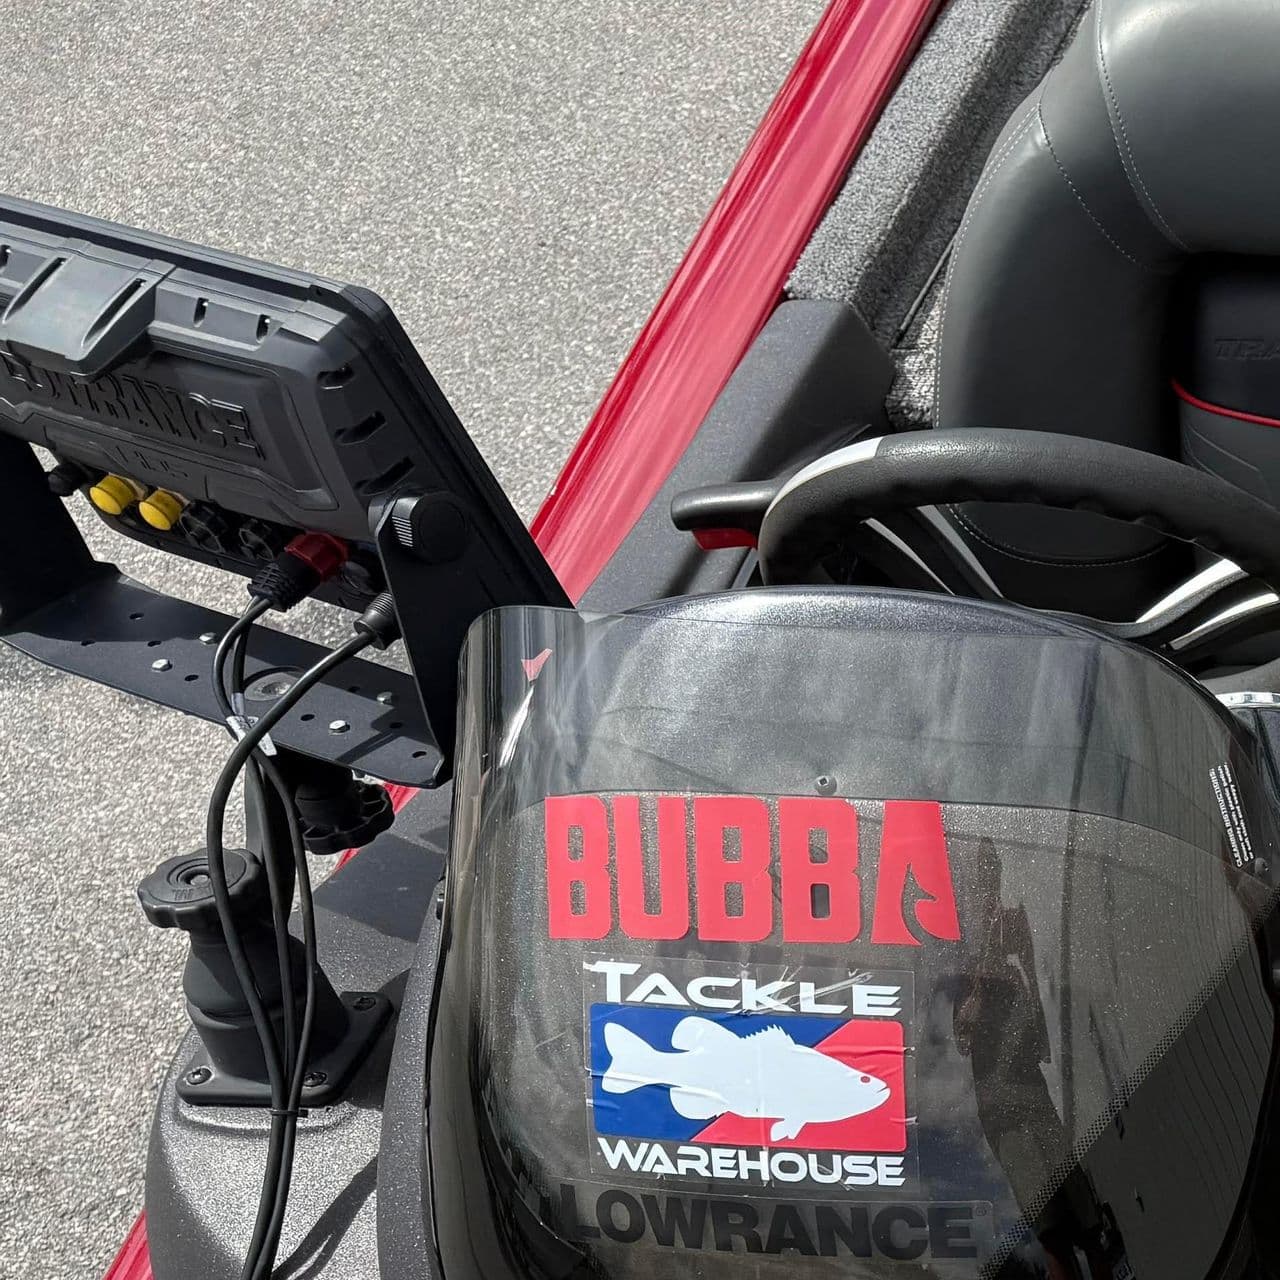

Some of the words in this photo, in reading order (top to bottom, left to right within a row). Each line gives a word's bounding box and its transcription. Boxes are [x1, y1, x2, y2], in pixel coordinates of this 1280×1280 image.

[544, 795, 961, 946] BUBBA
[585, 960, 902, 1017] TACKLE
[597, 1136, 906, 1187] WAREHOUSE
[560, 1185, 978, 1260] LOWRANCE
